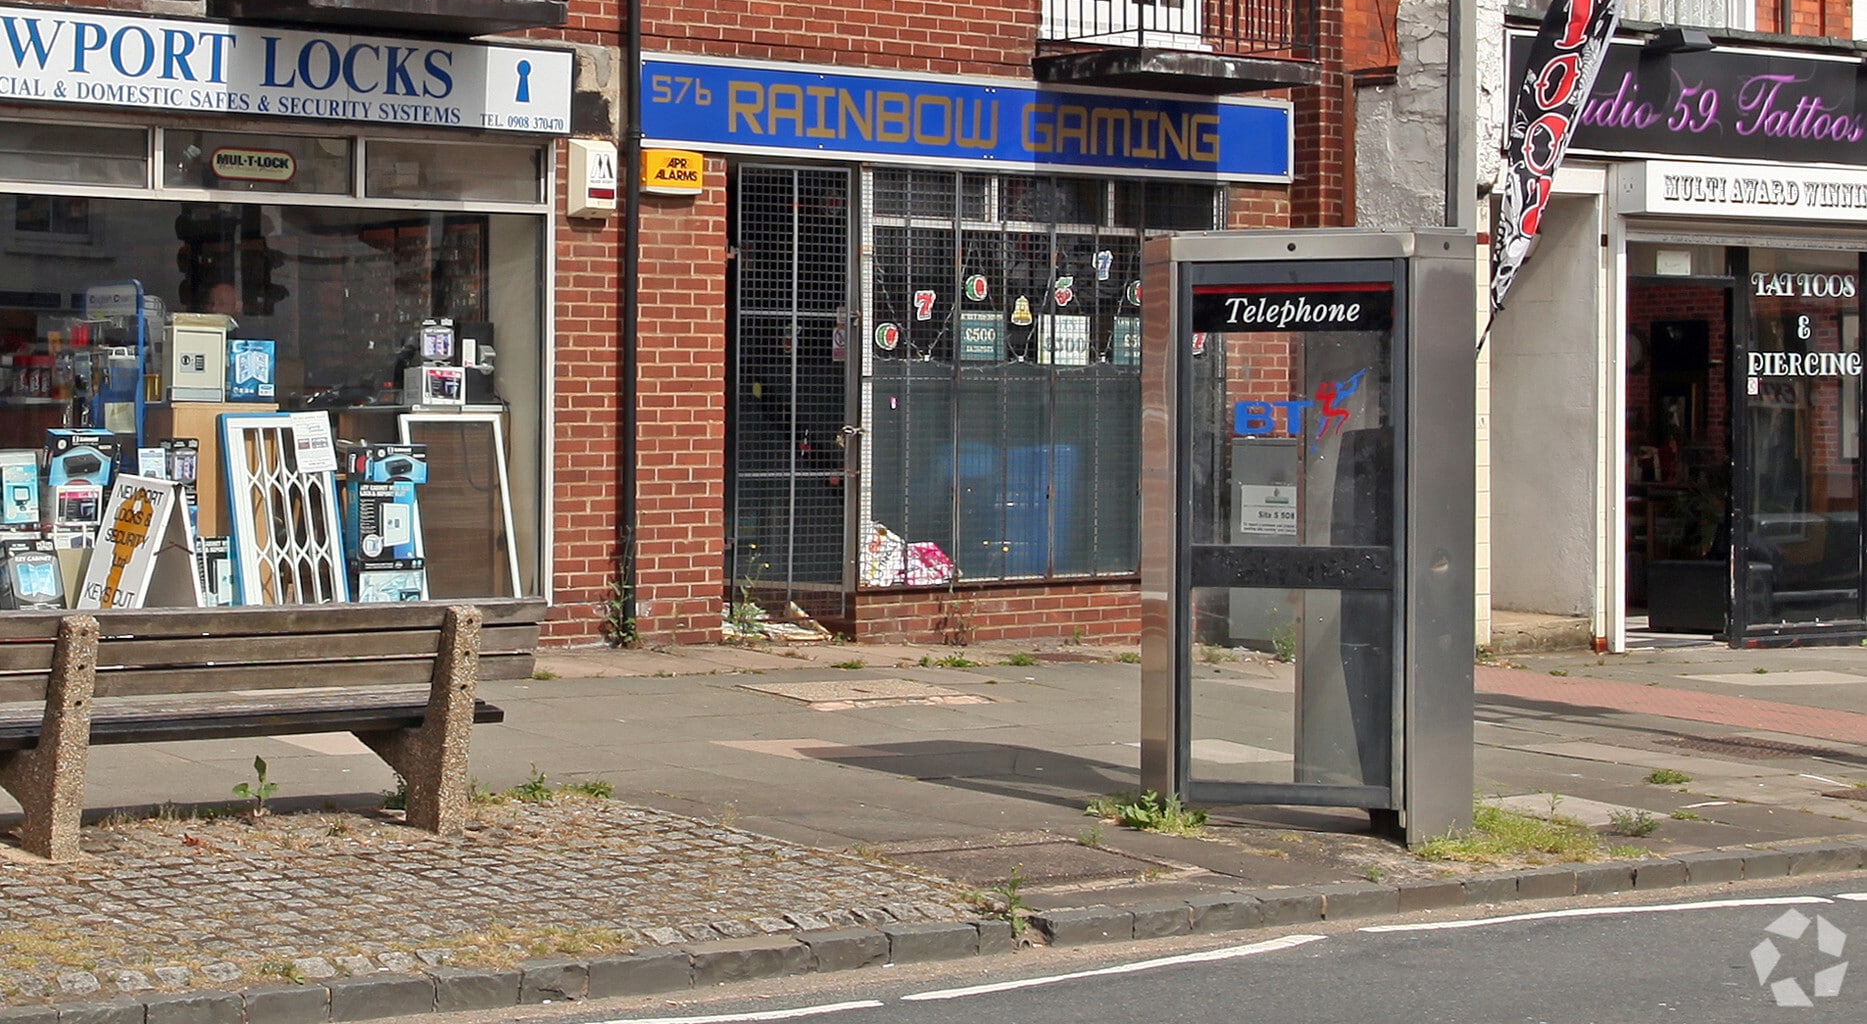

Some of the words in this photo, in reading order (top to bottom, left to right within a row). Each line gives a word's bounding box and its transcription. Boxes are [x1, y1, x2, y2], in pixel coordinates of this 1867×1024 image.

[260, 36, 454, 99] LOCKS
[53, 80, 67, 98] &
[77, 81, 183, 106] DOMESTIC
[190, 90, 249, 110] SAFES
[257, 95, 270, 113] &
[278, 95, 372, 119] SECURITY
[378, 102, 461, 125] SYSTEMS
[1580, 71, 1662, 129] udio
[1668, 77, 1721, 134] 59
[1736, 73, 1865, 143] Tattoos
[507, 115, 530, 129] 0908
[533, 116, 564, 131] 370470
[728, 80, 998, 150] RAINBOW
[1021, 103, 1220, 162] GAMING
[666, 157, 688, 169] APR
[654, 170, 698, 181] ALARMS
[1664, 175, 1727, 203] MULTI
[1731, 179, 1799, 205] AWARD
[1751, 272, 1855, 297] TATTOOS
[1225, 296, 1360, 328] Telephone
[964, 328, 996, 342] £500
[1798, 316, 1811, 339] &
[1748, 352, 1862, 376] PIERCING
[1233, 401, 1315, 435] BT
[117, 484, 164, 505] NEWPORT
[114, 506, 143, 526] LOCKS
[105, 528, 150, 549] SECURITY
[84, 582, 111, 603] KEYS
[112, 589, 135, 607] CUT
